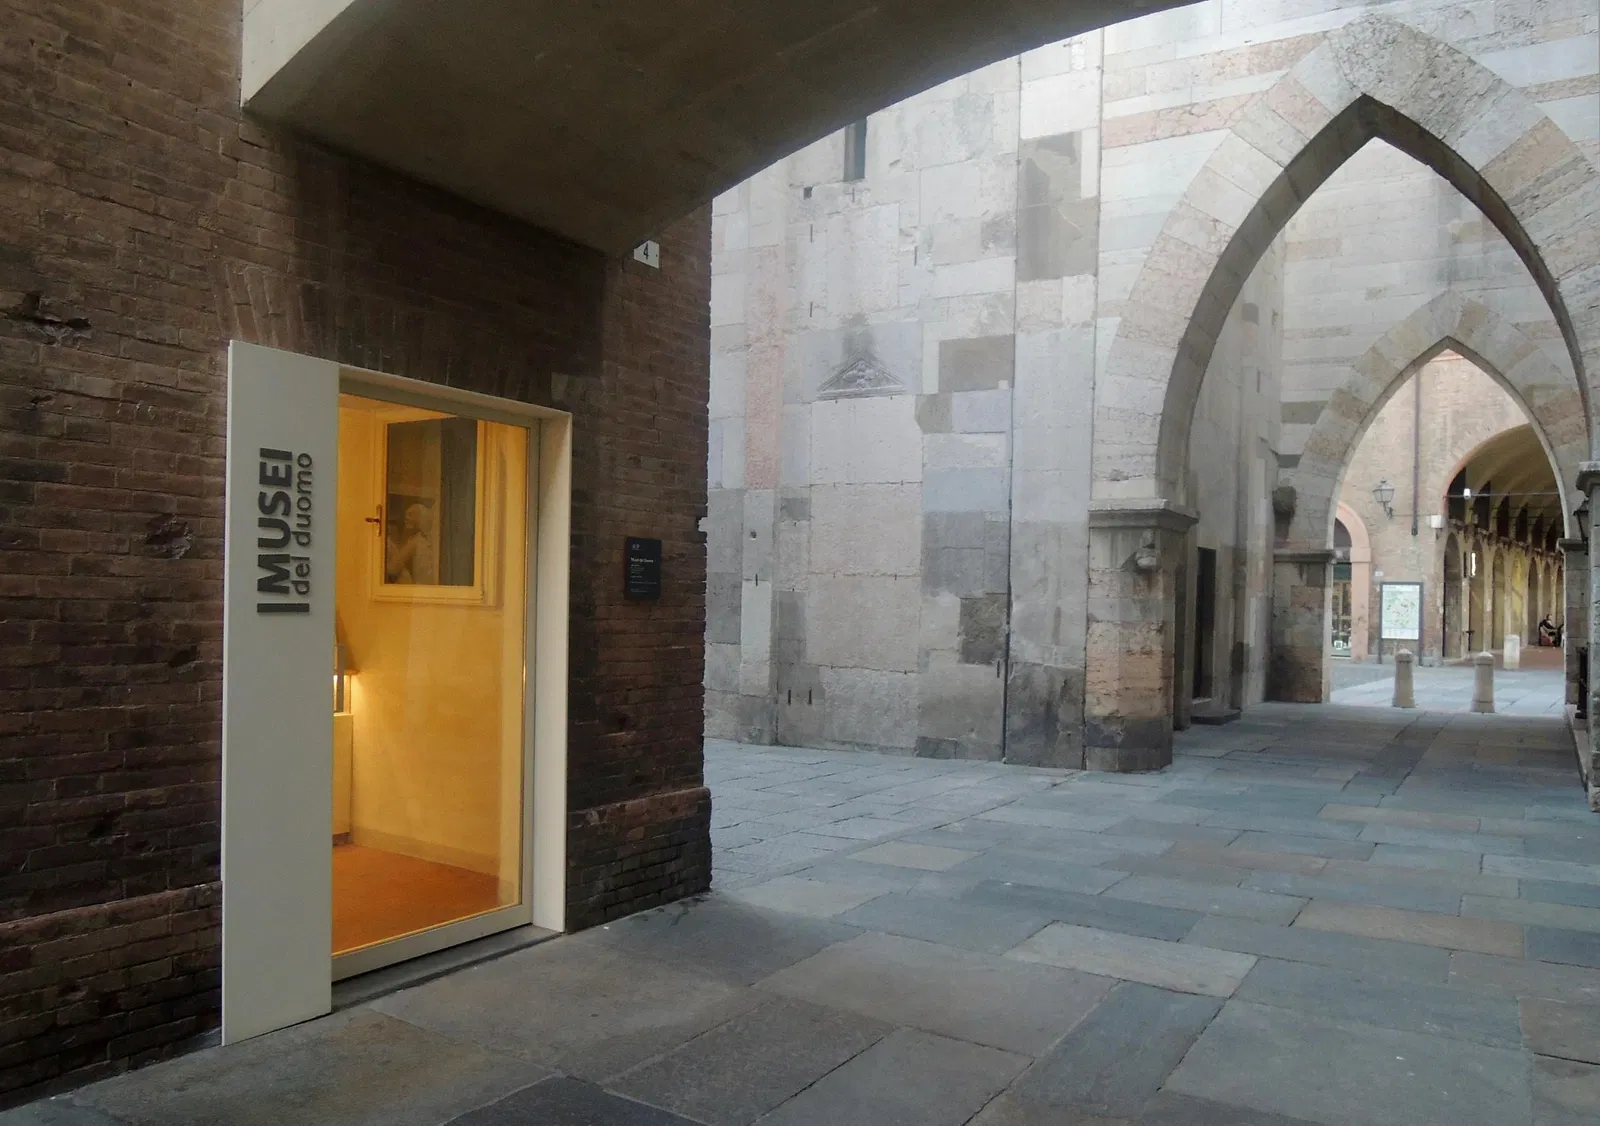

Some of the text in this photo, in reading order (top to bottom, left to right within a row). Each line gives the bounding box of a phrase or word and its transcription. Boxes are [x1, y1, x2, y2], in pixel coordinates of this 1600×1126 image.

[643, 242, 649, 260] 4
[257, 447, 293, 595] MUSEI
[291, 452, 312, 596] del duomo
